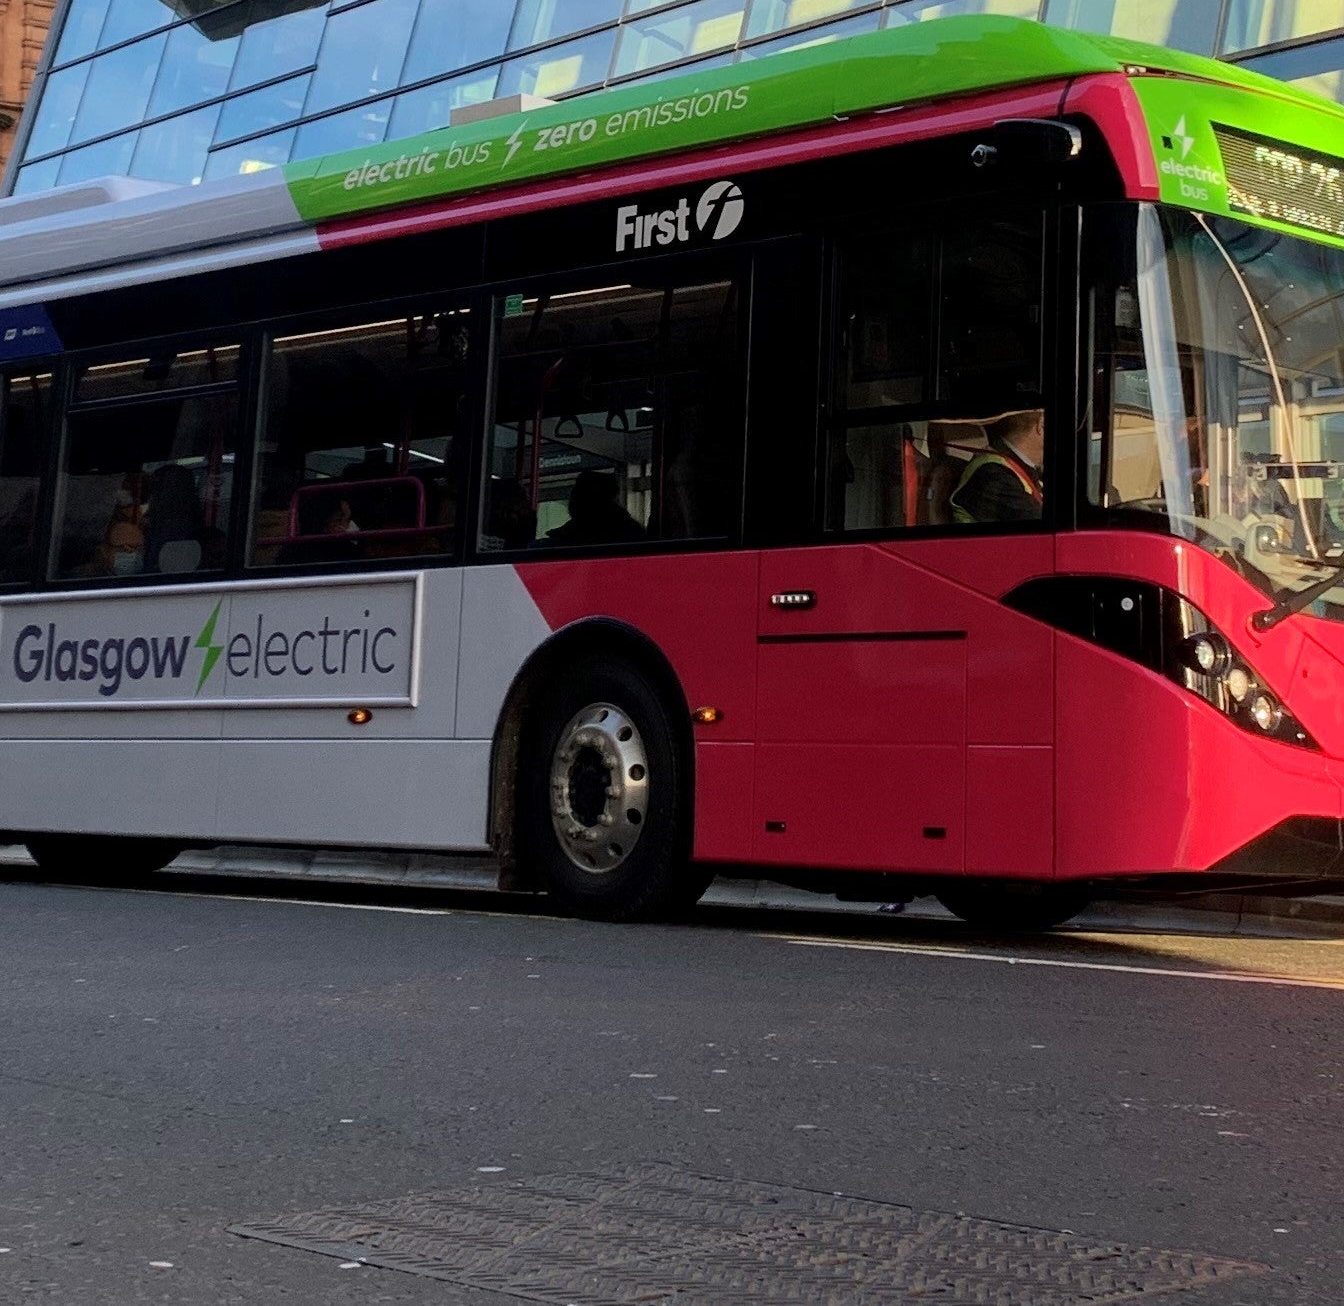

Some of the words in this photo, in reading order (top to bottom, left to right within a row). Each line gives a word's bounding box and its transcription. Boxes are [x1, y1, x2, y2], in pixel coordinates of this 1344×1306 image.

[343, 149, 440, 191] electric
[444, 138, 493, 171] bus
[533, 116, 598, 152] zero
[604, 84, 751, 137] emissions
[1160, 158, 1223, 185] electric
[1179, 178, 1209, 201] bus
[615, 198, 689, 252] First
[13, 622, 191, 697] Glasgow
[226, 608, 398, 678] electric
